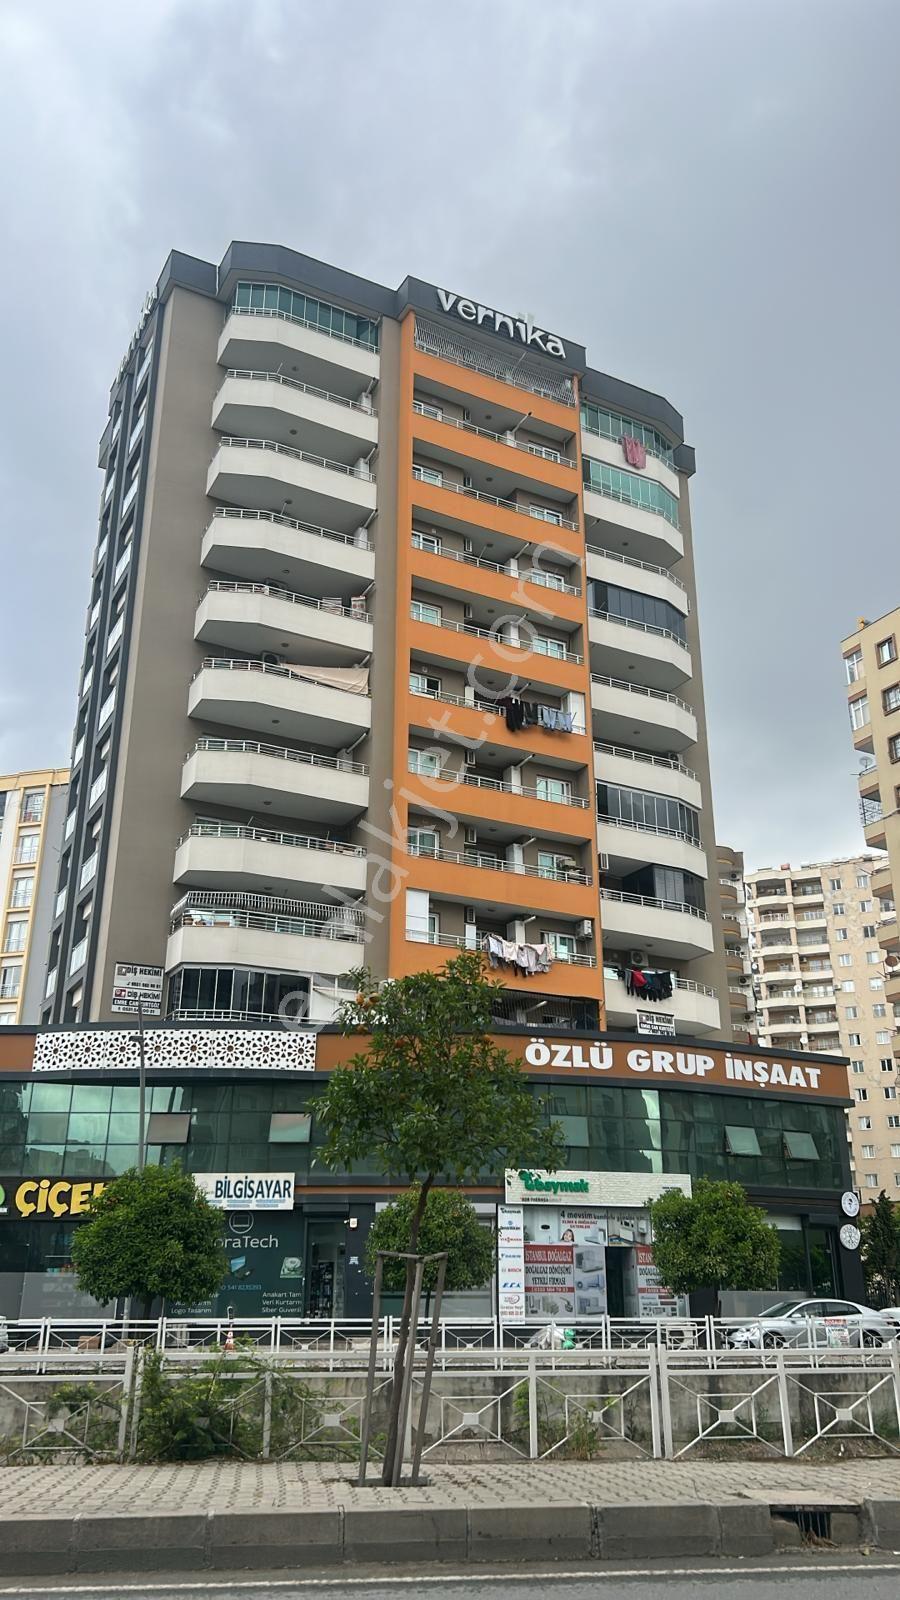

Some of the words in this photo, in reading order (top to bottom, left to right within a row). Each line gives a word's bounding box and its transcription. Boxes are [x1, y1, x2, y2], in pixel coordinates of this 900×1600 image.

[437, 288, 567, 359] vernika
[525, 1037, 613, 1070] ÖZLÜ
[626, 1049, 715, 1077] GRUP
[725, 1053, 821, 1089] İNŞAAT
[214, 1175, 292, 1199] BİLGİSAYAR
[567, 1210, 593, 1219] mevsim
[213, 1234, 279, 1249] oraTech
